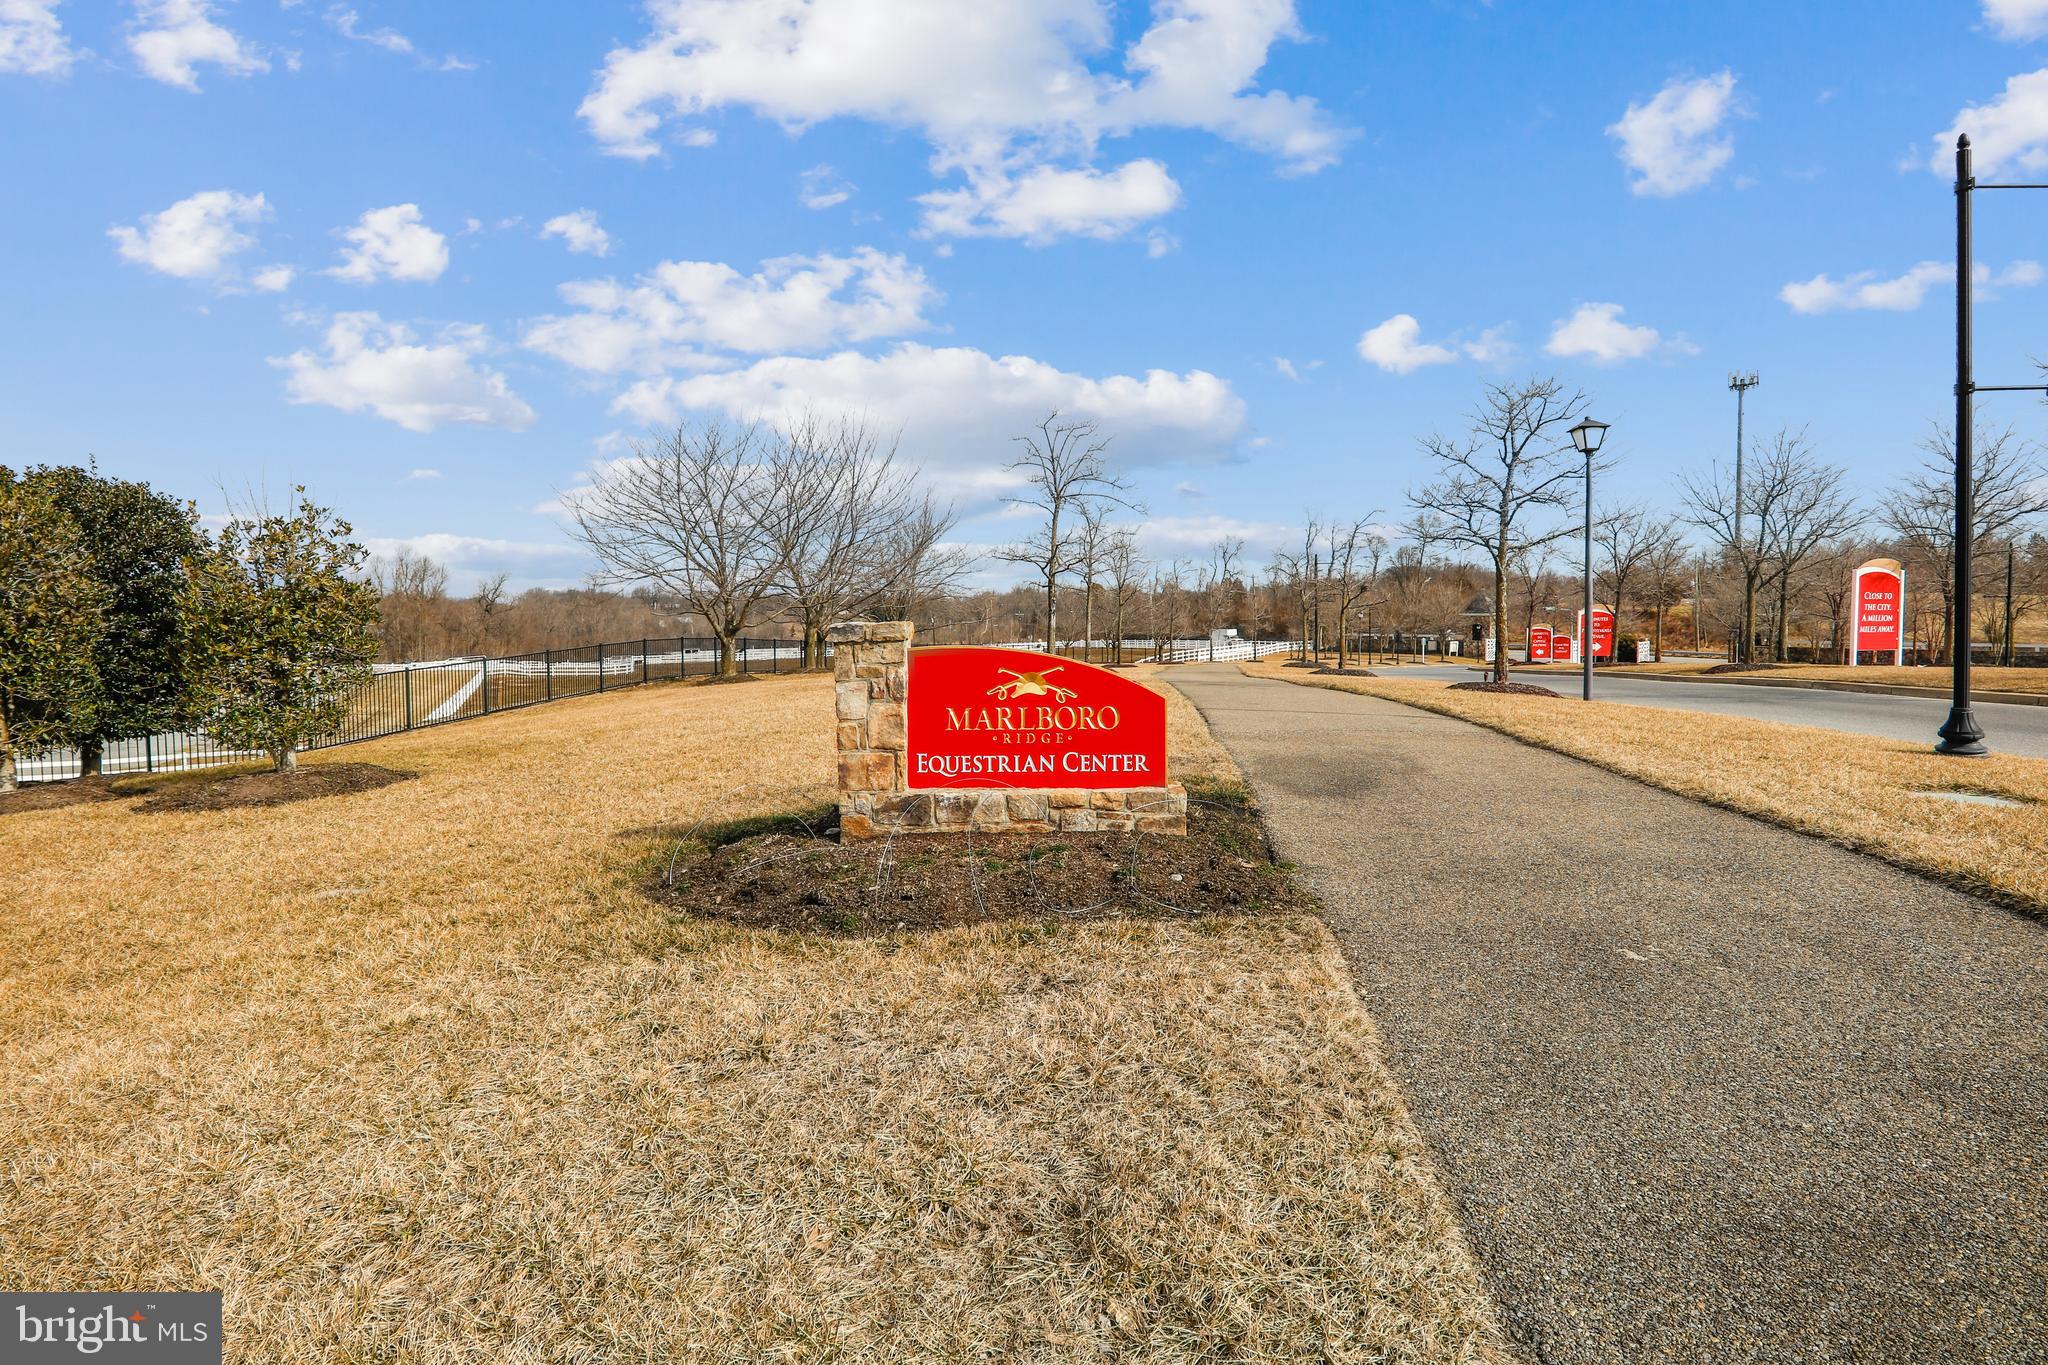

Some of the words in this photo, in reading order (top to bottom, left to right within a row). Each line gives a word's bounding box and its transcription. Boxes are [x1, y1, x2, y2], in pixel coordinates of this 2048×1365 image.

[1864, 592, 1883, 600] CLOSE
[1861, 614, 1867, 622] A
[945, 706, 1120, 731] MARLBORO
[1002, 733, 1064, 744] RIDGE
[916, 753, 1054, 777] EQUESTRIAN
[1063, 752, 1150, 772] CENTER
